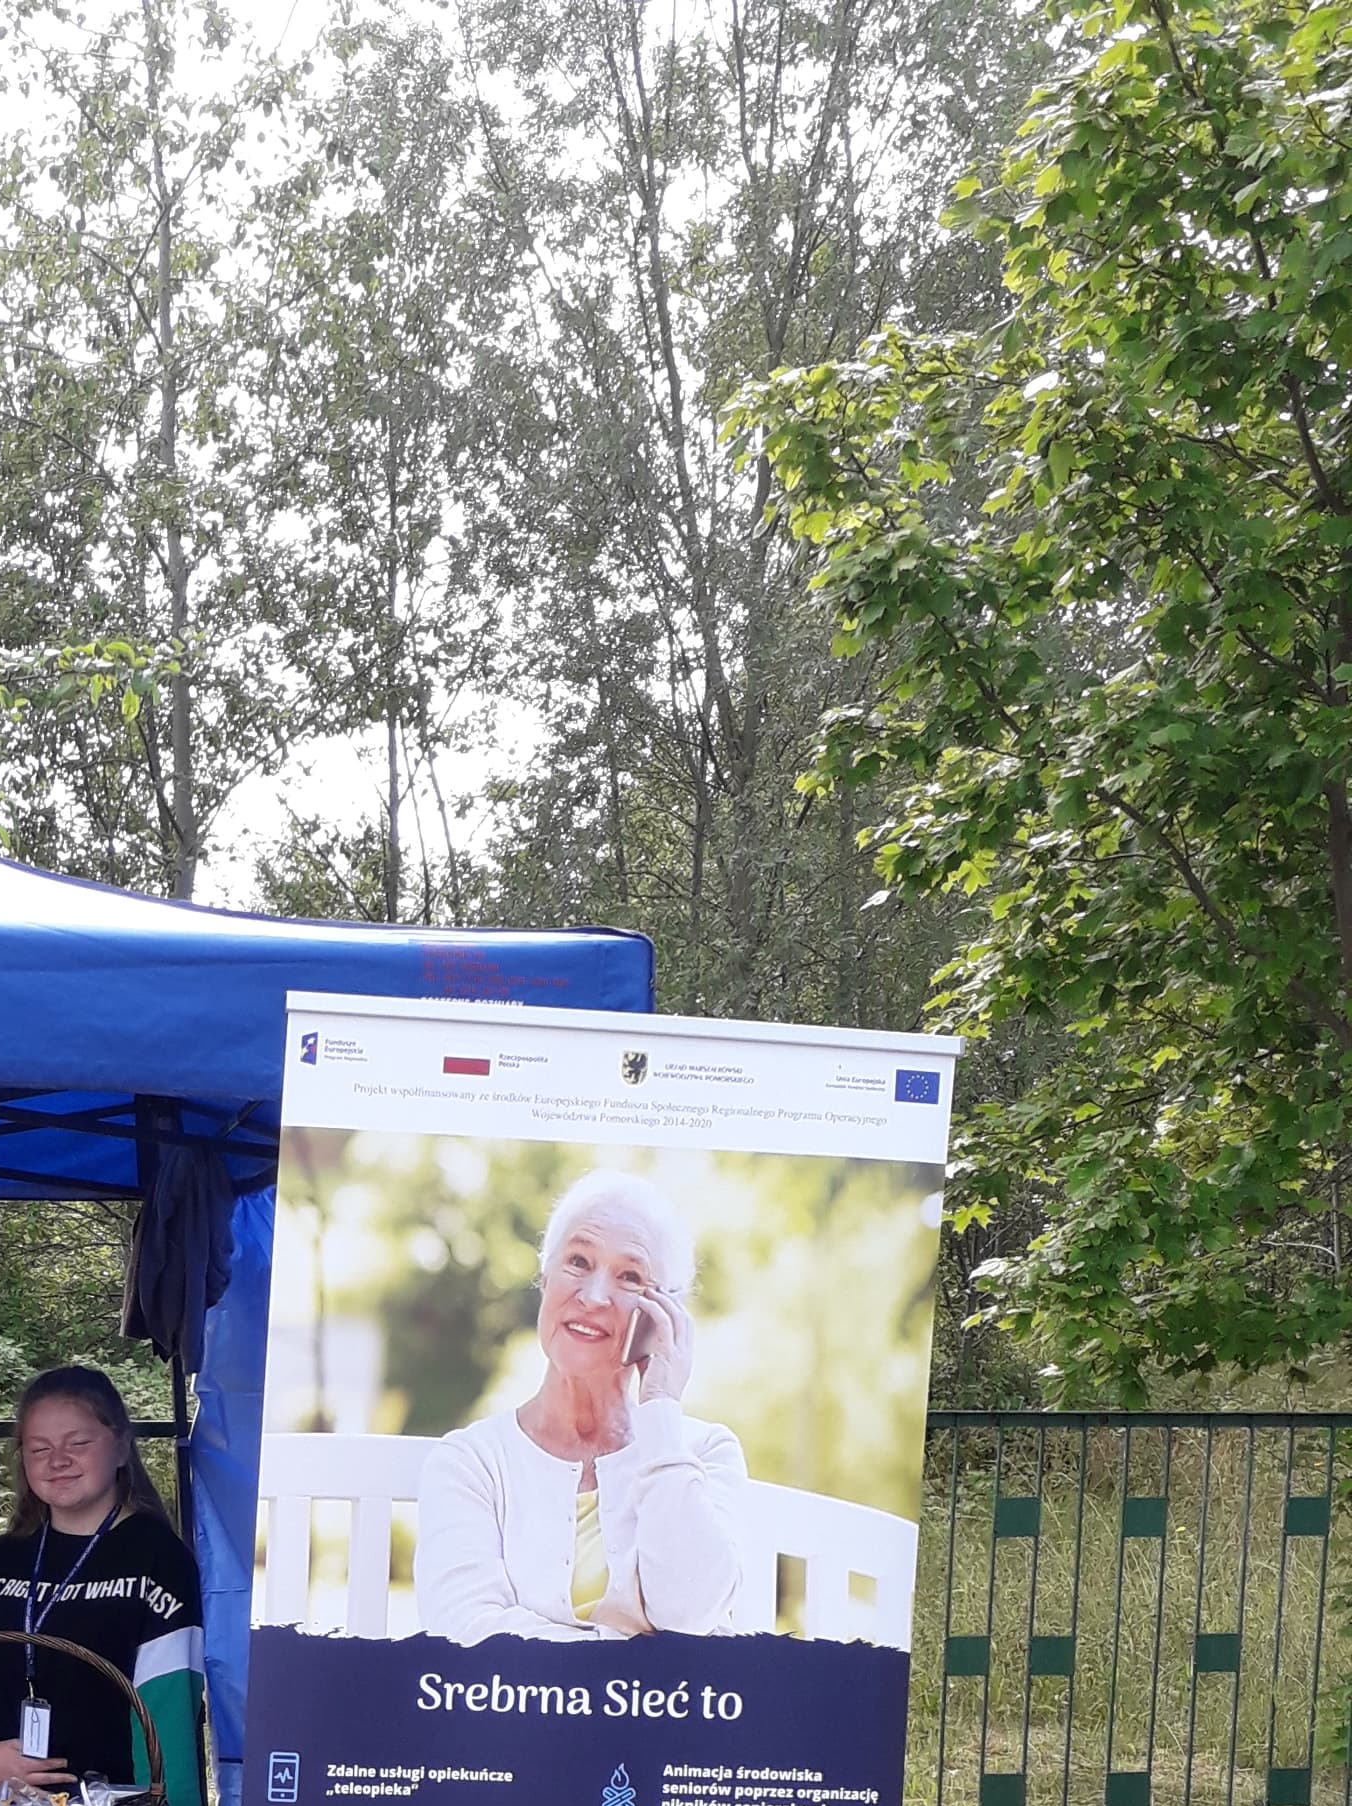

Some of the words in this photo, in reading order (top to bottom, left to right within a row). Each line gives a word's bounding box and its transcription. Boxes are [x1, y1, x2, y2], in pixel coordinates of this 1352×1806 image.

[85, 1577, 138, 1600] WHAT
[417, 1673, 592, 1715] Srebrna
[603, 1679, 689, 1718] Sieć
[700, 1685, 742, 1720] to
[326, 1764, 376, 1783] Zdalne
[379, 1765, 425, 1784] usługi
[428, 1766, 513, 1783] opiekuńcze
[662, 1764, 733, 1782] Animacja
[736, 1766, 822, 1782] środowiska
[662, 1781, 732, 1801] seniorów
[734, 1786, 794, 1802] poprzez
[796, 1787, 878, 1804] organizację
